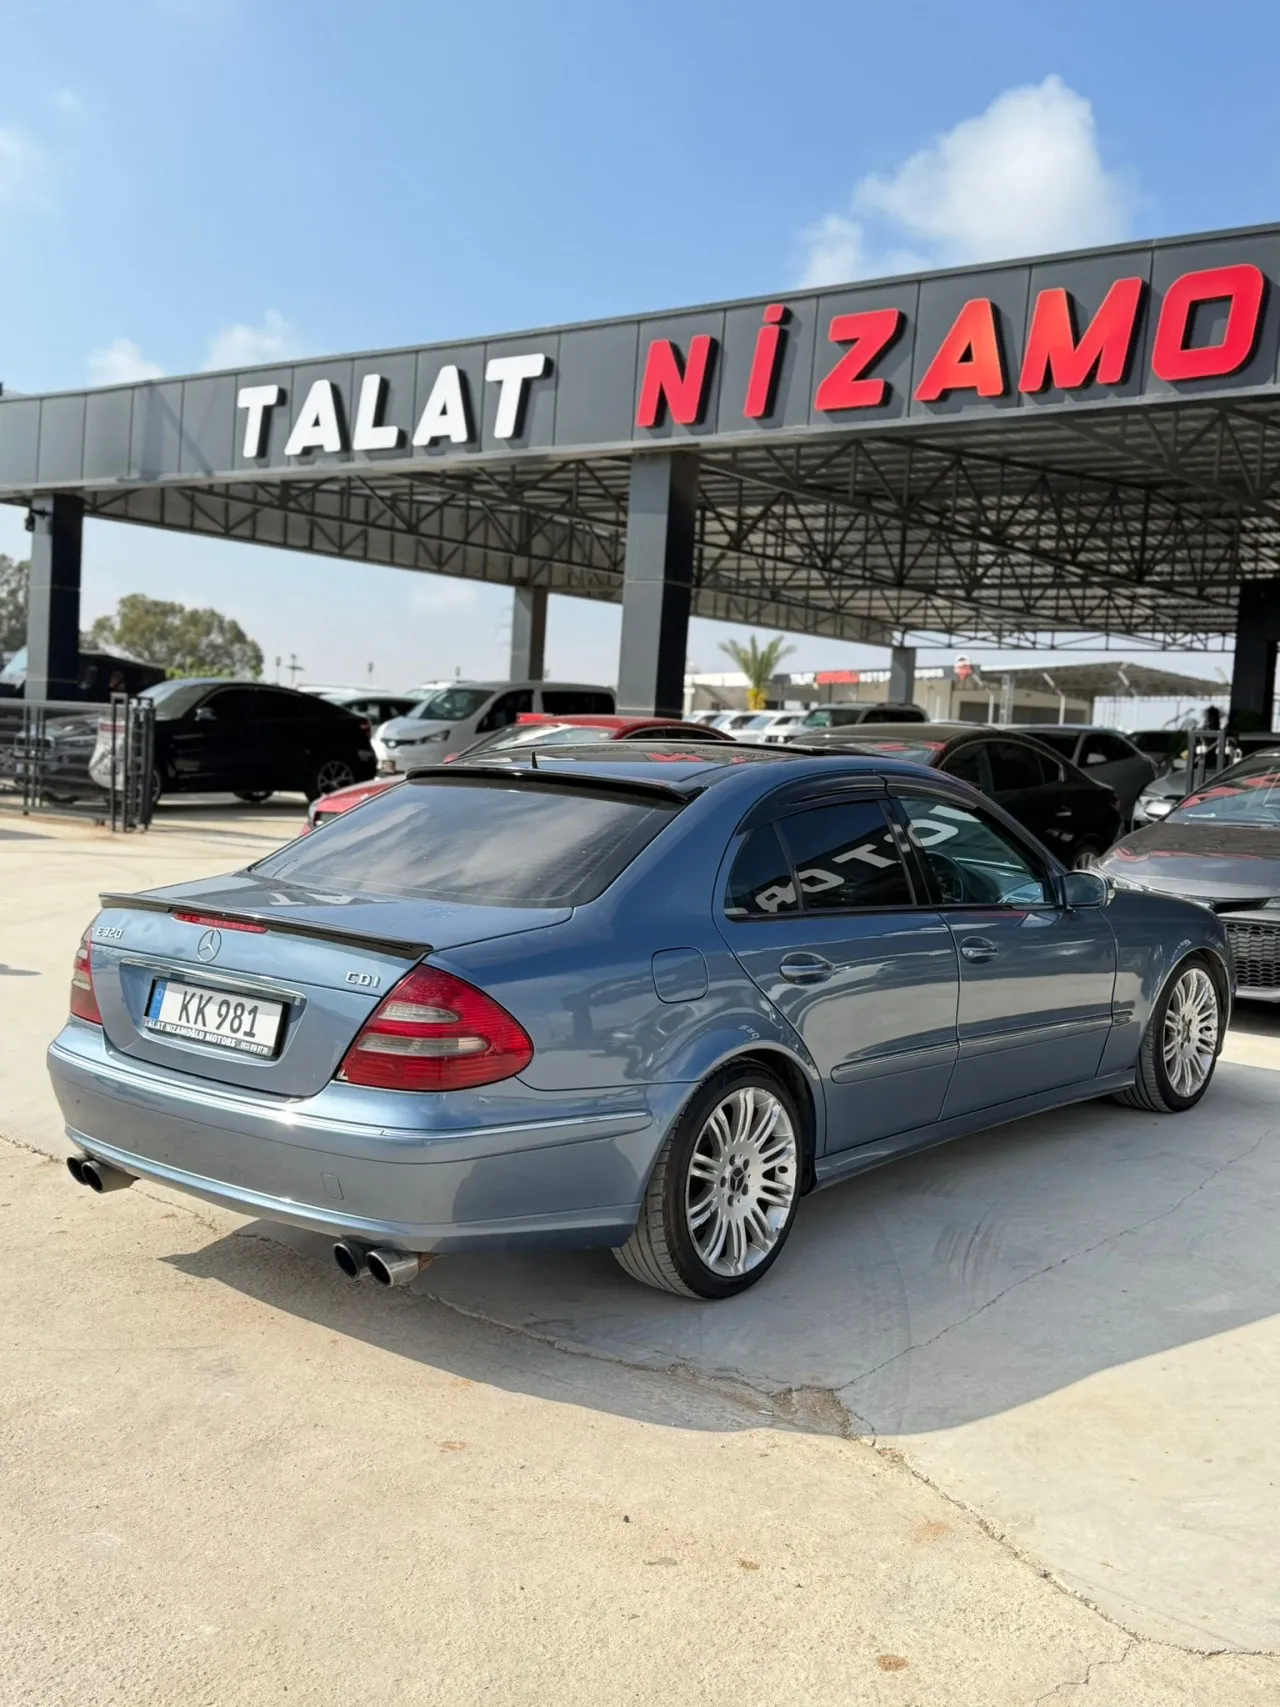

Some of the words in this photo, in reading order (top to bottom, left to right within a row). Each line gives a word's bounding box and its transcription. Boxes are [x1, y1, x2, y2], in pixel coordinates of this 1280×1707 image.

[237, 353, 546, 458] TALAT
[637, 264, 1265, 427] NİZAMO
[345, 970, 381, 988] CDI
[143, 1018, 166, 1031] TALAT
[205, 1032, 237, 1048] MOTORS
[178, 990, 213, 1028] KK
[215, 999, 260, 1039] 981
